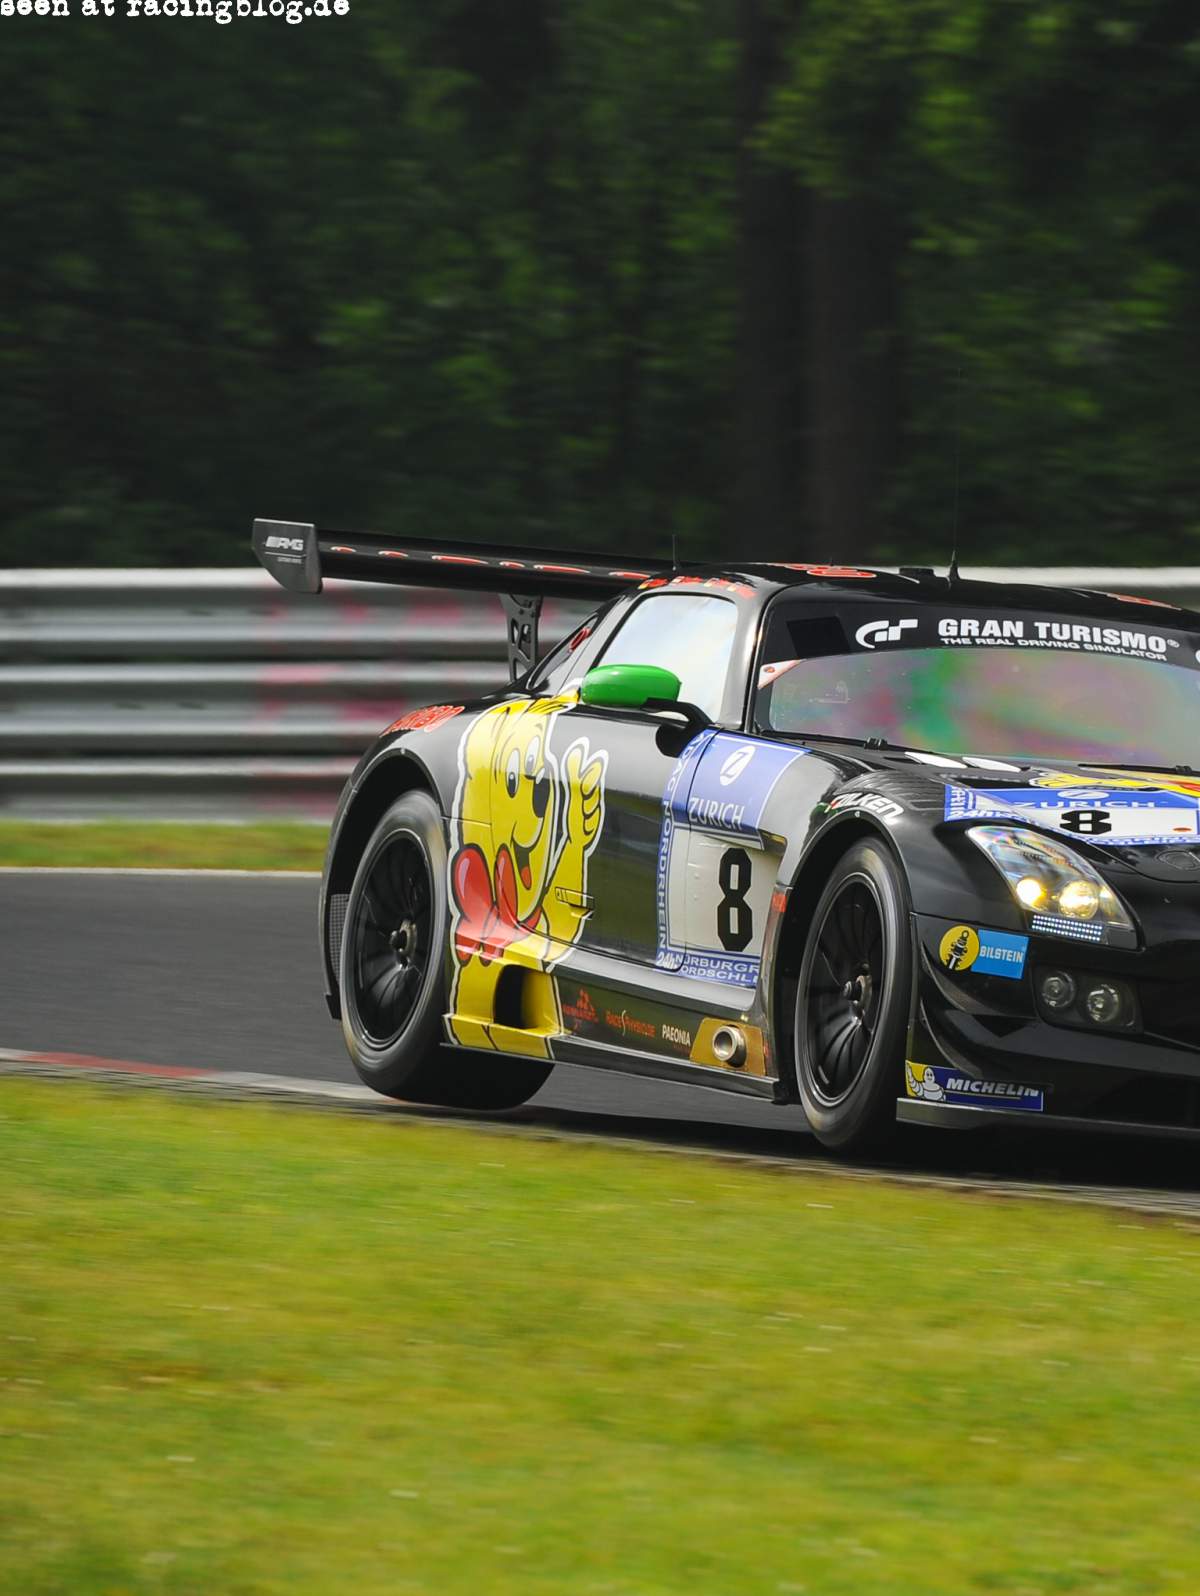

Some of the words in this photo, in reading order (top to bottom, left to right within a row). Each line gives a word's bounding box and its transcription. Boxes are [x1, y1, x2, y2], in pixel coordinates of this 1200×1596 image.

[938, 618, 1024, 638] GRAN
[940, 637, 973, 646] THE
[975, 638, 1015, 646] REAL
[1016, 638, 1081, 649] DRIVING
[1082, 643, 1168, 661] SIMULATOR
[687, 796, 746, 830] ZURICH
[1059, 809, 1112, 835] 8
[717, 847, 754, 952] 8
[979, 945, 1024, 963] BILSTEIN
[662, 1024, 692, 1047] PAEONIA
[946, 1077, 1039, 1097] MICHELIN
